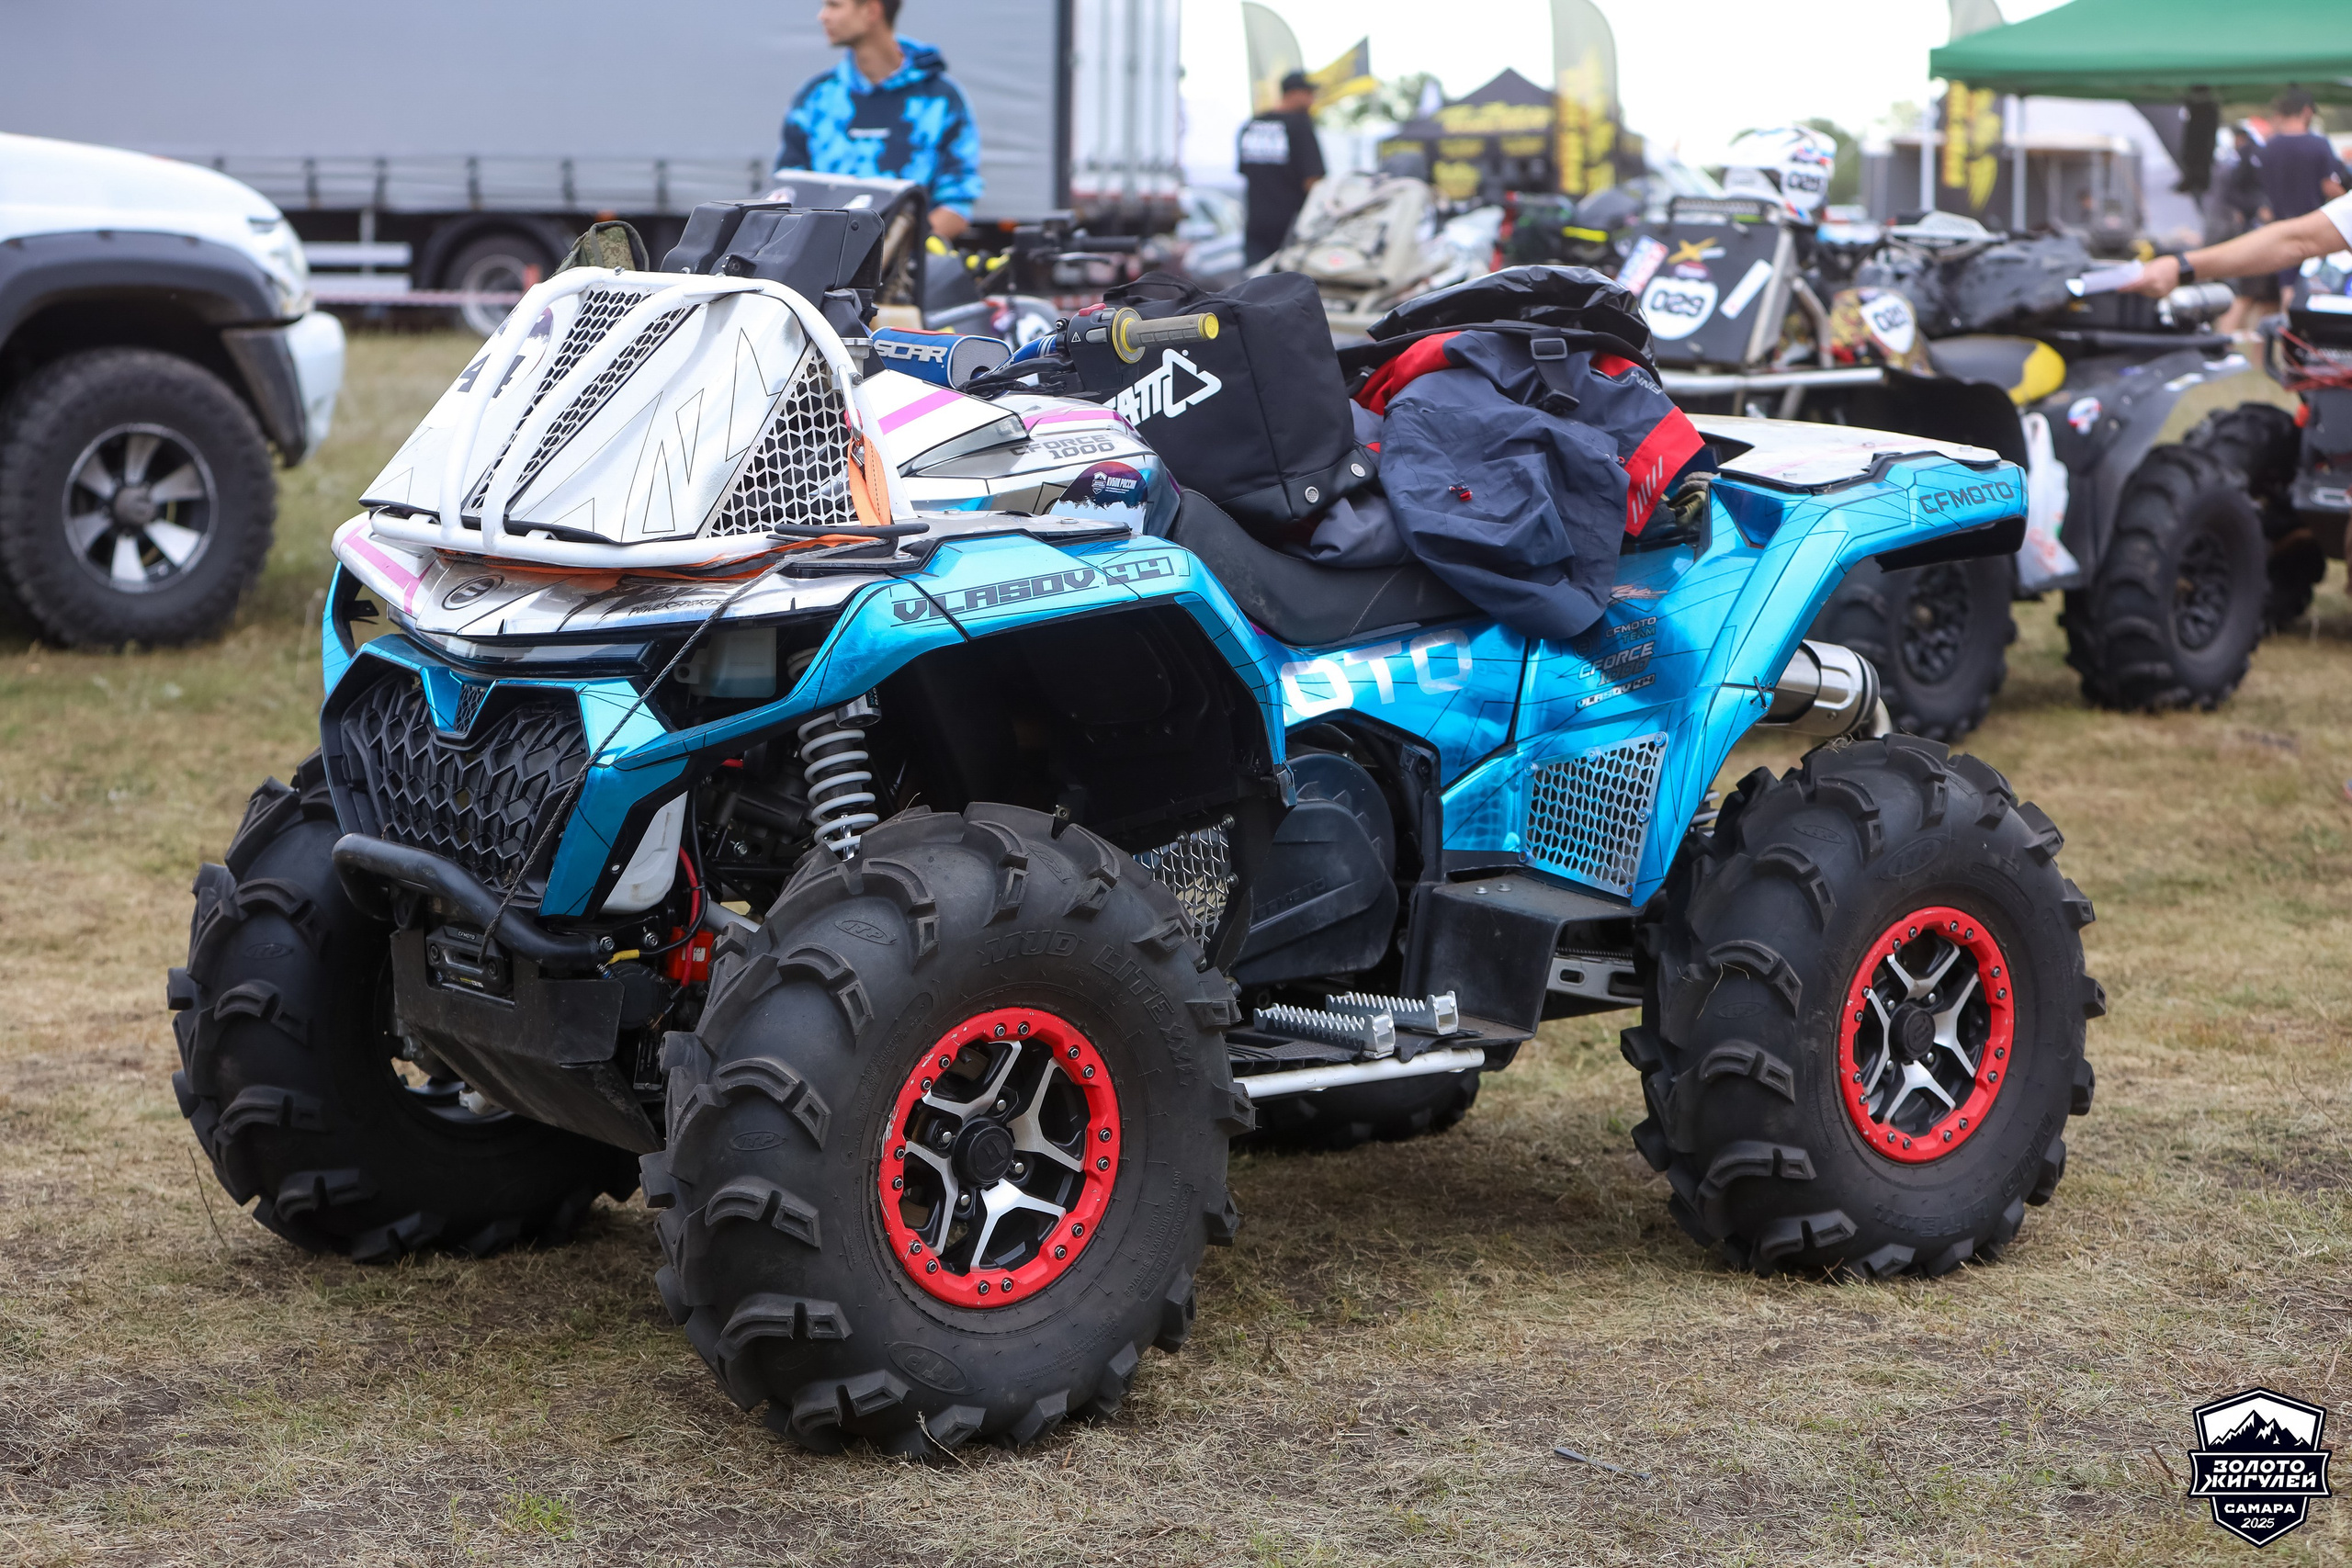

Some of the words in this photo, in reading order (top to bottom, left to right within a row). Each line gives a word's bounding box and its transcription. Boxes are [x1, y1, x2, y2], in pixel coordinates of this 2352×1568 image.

[874, 339, 948, 364] SCAR
[1010, 434, 1111, 457] CFORCE
[1048, 442, 1115, 460] 1000
[1919, 481, 2014, 514] CFMOTO
[893, 569, 1096, 623] VLASOV
[1103, 557, 1175, 586] 44
[1605, 616, 1657, 639] CFMOTO
[1623, 626, 1657, 645] TEAM
[1578, 641, 1656, 681] CFORCE
[1597, 656, 1652, 687] 1000
[845, 924, 885, 939] ITP
[981, 930, 1080, 967] MUD
[1091, 943, 1175, 1024] LITE
[866, 1029, 903, 1090] CONSTRUCTION
[741, 1133, 777, 1148] ITP
[1165, 1193, 1177, 1214] FOR
[1136, 1210, 1160, 1257] TUBELESS
[1148, 1213, 1171, 1260] HIGHWAY
[1156, 1250, 1170, 1272] NHS
[1124, 1259, 1150, 1298] SERVICE
